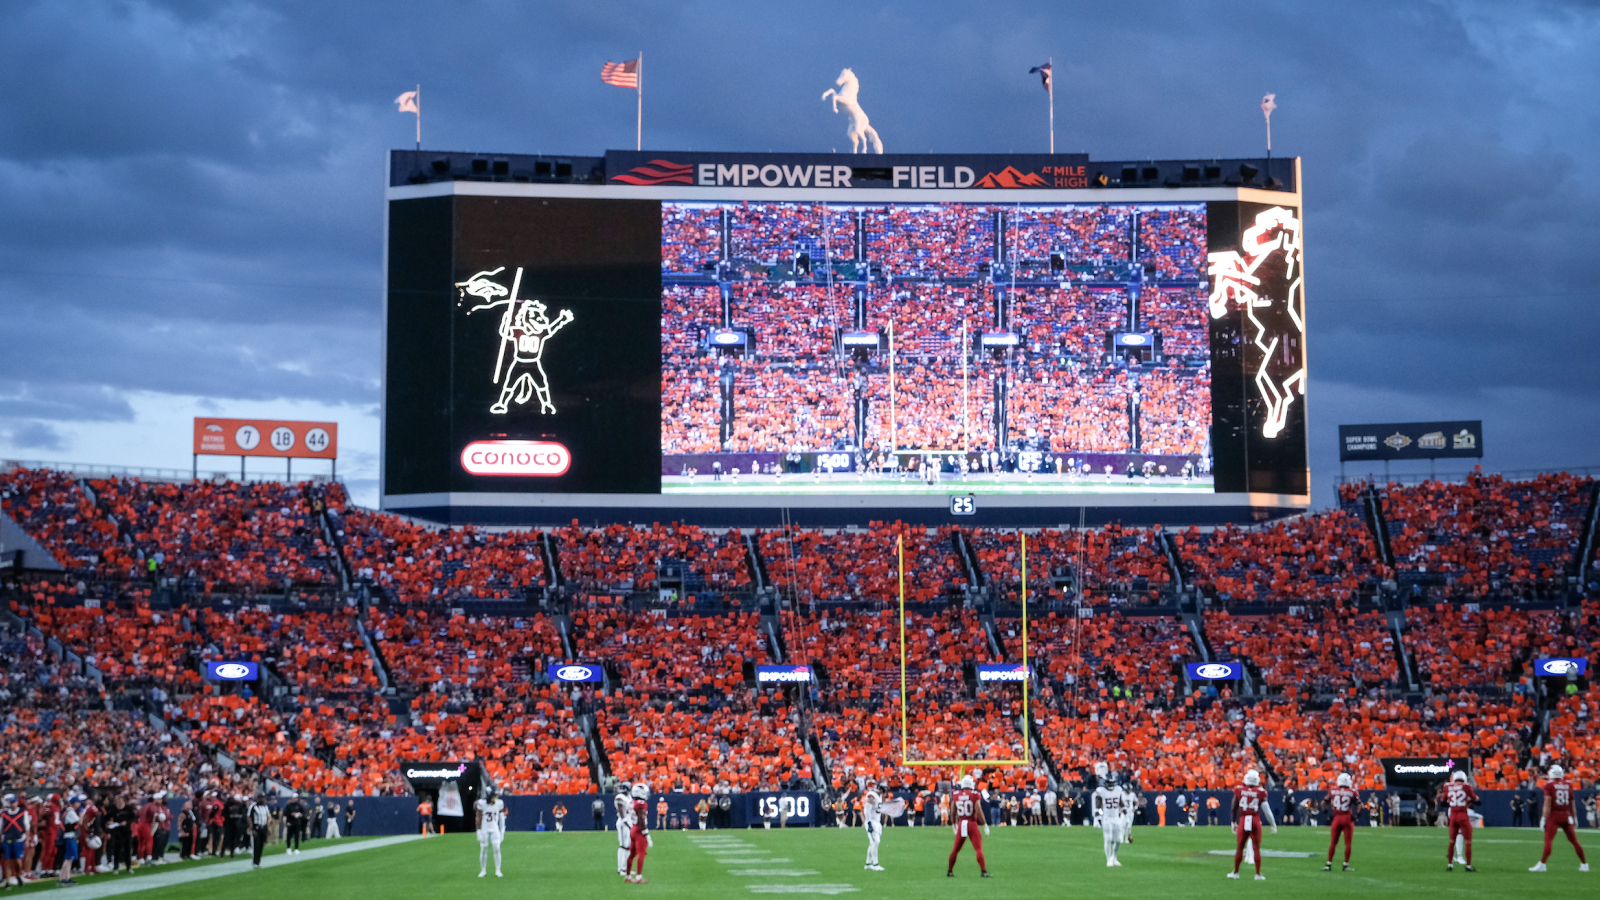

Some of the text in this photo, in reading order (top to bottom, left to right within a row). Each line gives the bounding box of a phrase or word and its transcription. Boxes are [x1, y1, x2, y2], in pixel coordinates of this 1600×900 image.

[698, 163, 975, 188] EMPOWER FIELD
[1041, 166, 1086, 176] AT MILE
[1054, 177, 1088, 188] HIGH
[243, 430, 252, 445] 7
[275, 431, 291, 446] 18
[308, 433, 325, 447] 44
[953, 497, 973, 512] 25
[759, 672, 810, 682] EMPOWER
[1105, 797, 1119, 810] 55
[1239, 796, 1260, 813] 44
[1333, 795, 1351, 812] 42
[1448, 790, 1467, 807] 32
[1555, 790, 1570, 806] 81
[956, 800, 974, 817] 50
[486, 811, 497, 822] 31
